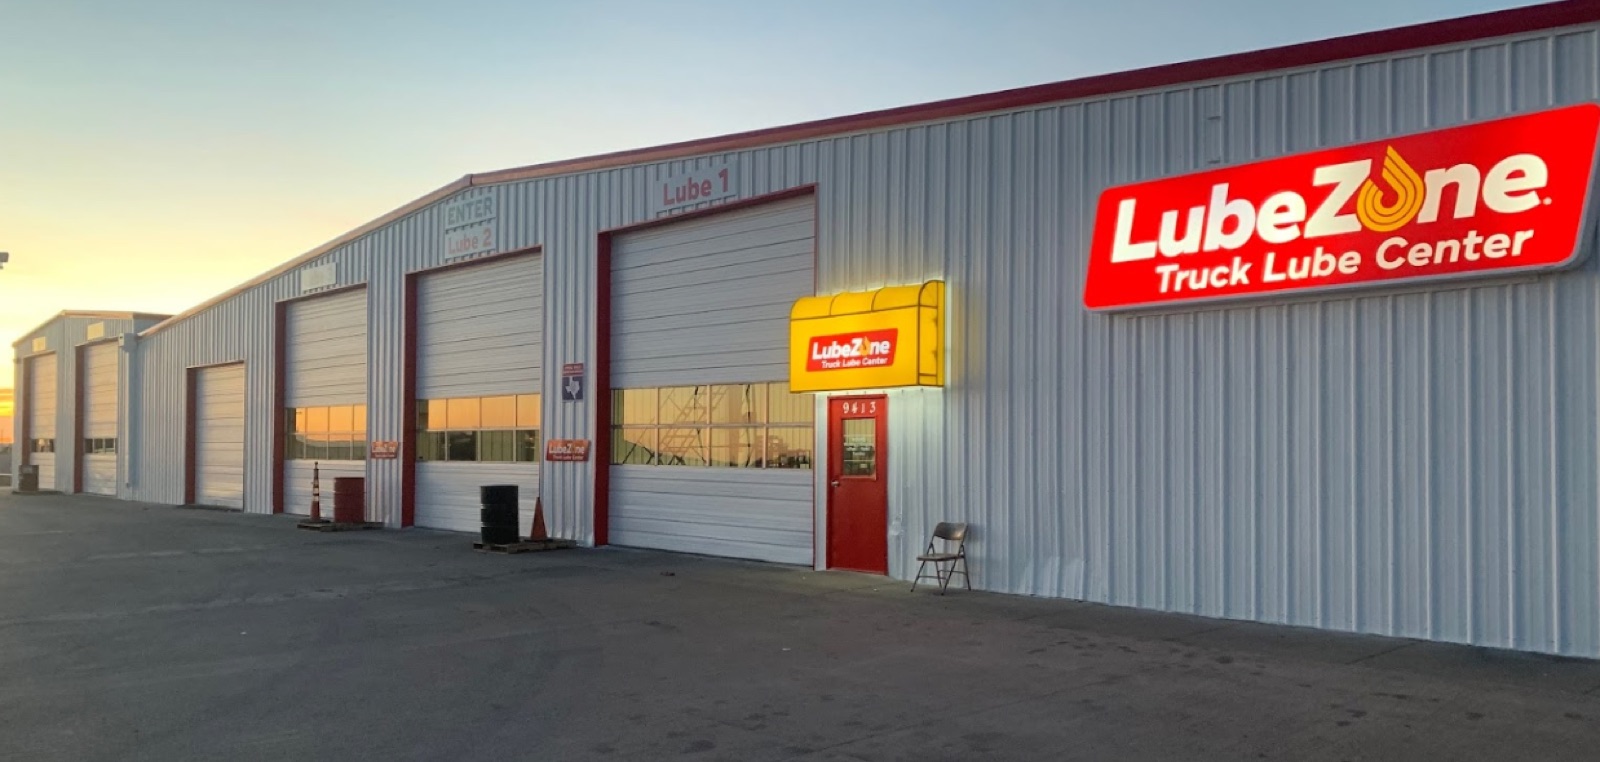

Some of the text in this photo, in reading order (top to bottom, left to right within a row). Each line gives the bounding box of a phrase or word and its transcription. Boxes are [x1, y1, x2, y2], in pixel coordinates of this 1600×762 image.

[663, 168, 729, 206] Lube 1
[448, 196, 492, 226] ENTER
[448, 227, 492, 255] Lube 2
[1156, 230, 1534, 293] Truck Lube Center
[812, 336, 890, 360] LubeZone
[822, 356, 888, 369] Truck Lube Center
